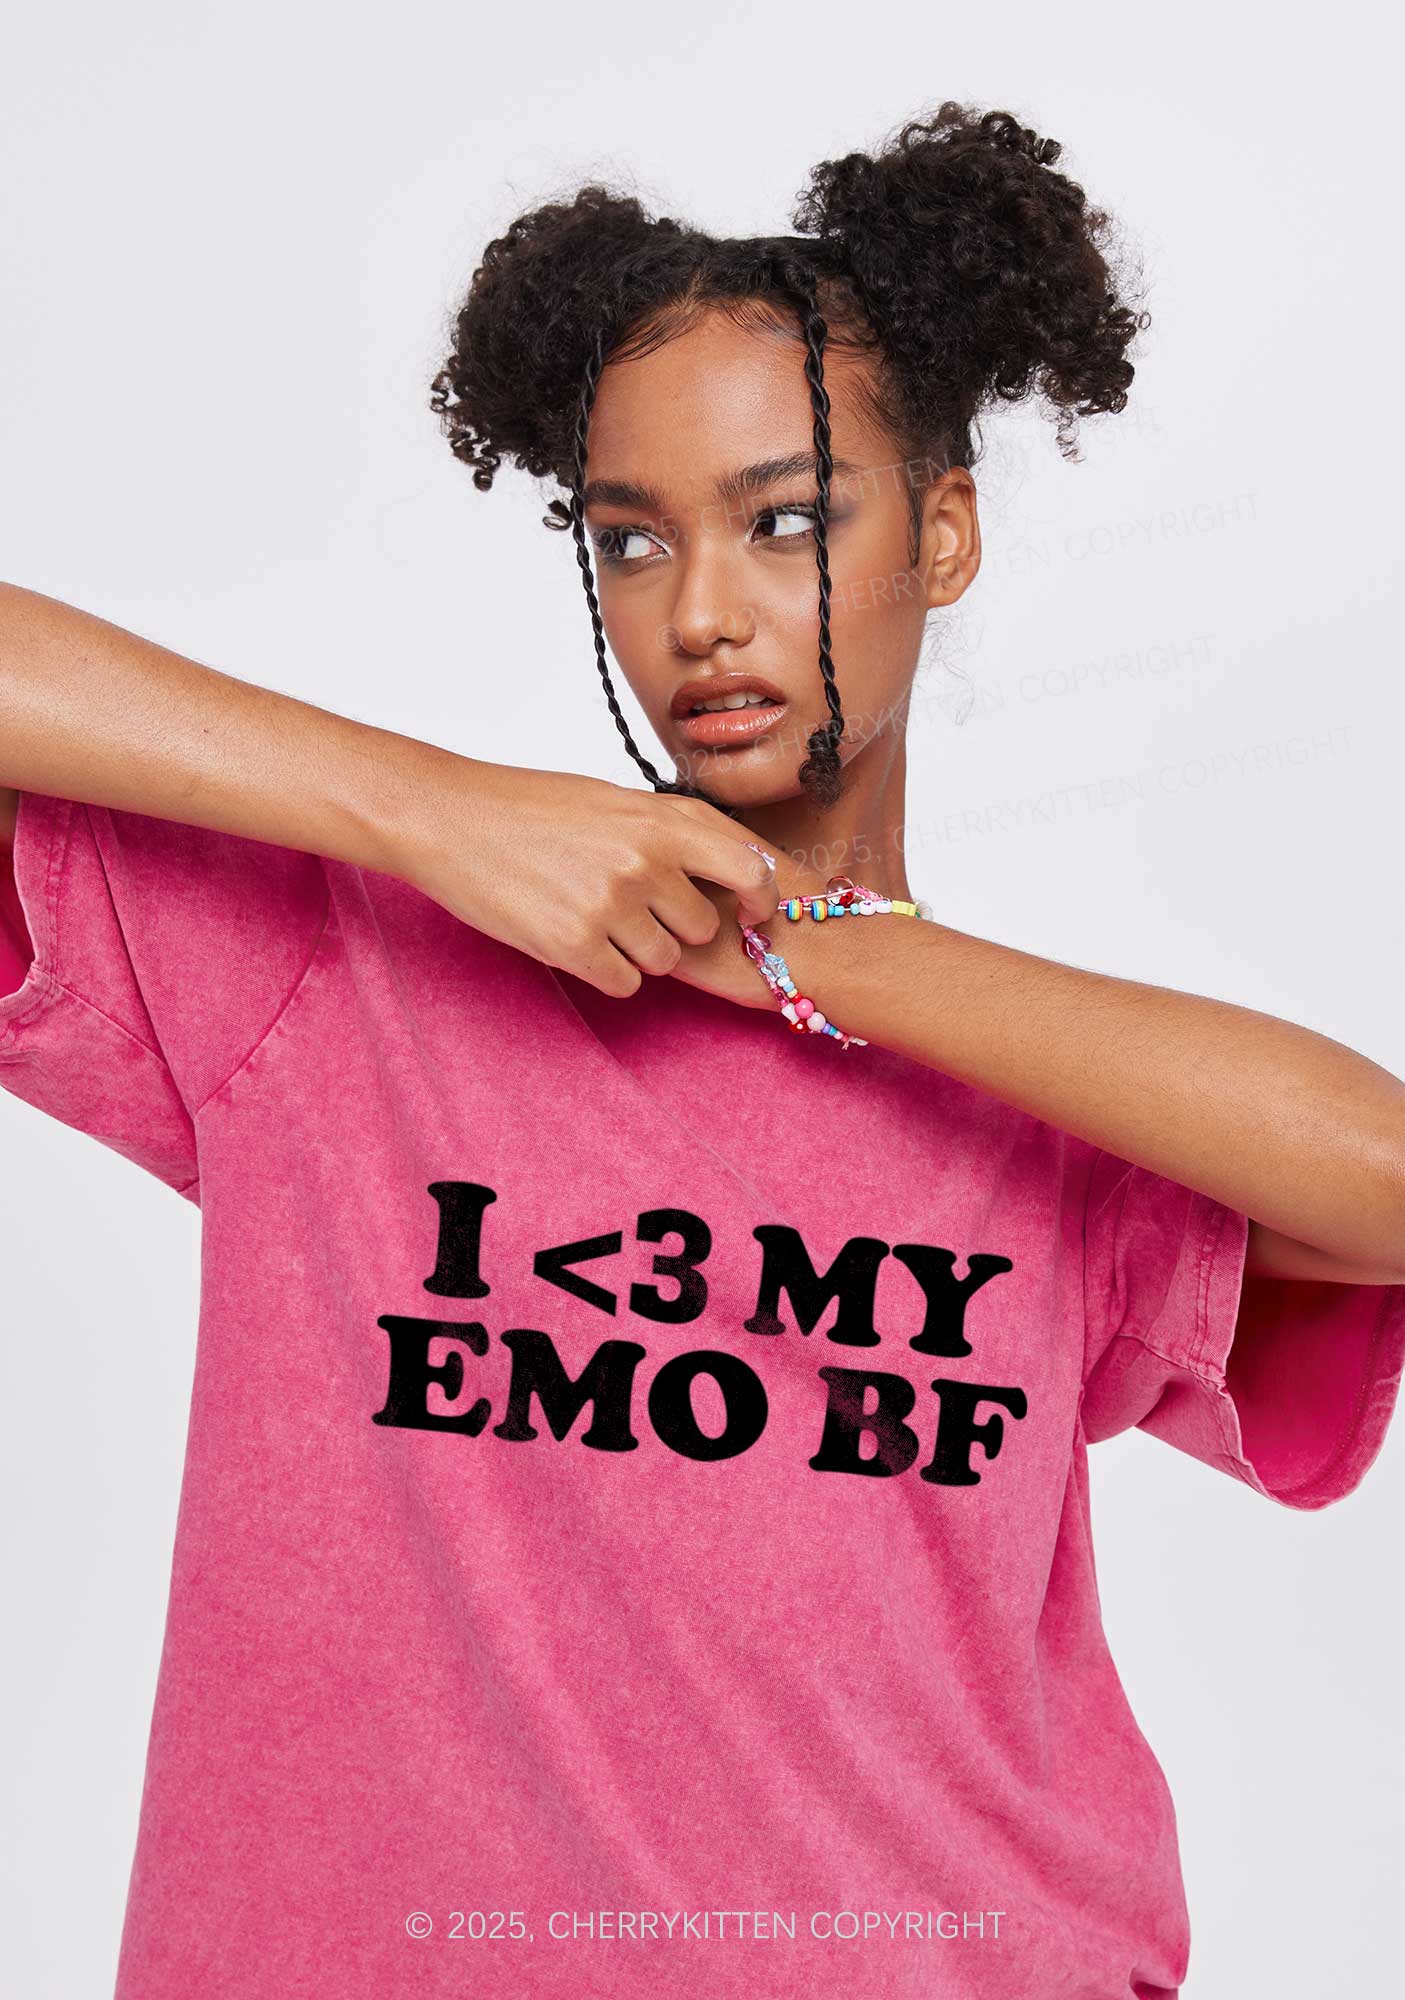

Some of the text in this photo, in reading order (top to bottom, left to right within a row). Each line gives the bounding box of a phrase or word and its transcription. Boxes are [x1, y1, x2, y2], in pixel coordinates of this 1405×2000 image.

[423, 1180, 498, 1299] I
[743, 1224, 1014, 1358] MY
[371, 1313, 1028, 1487] EMO BF
